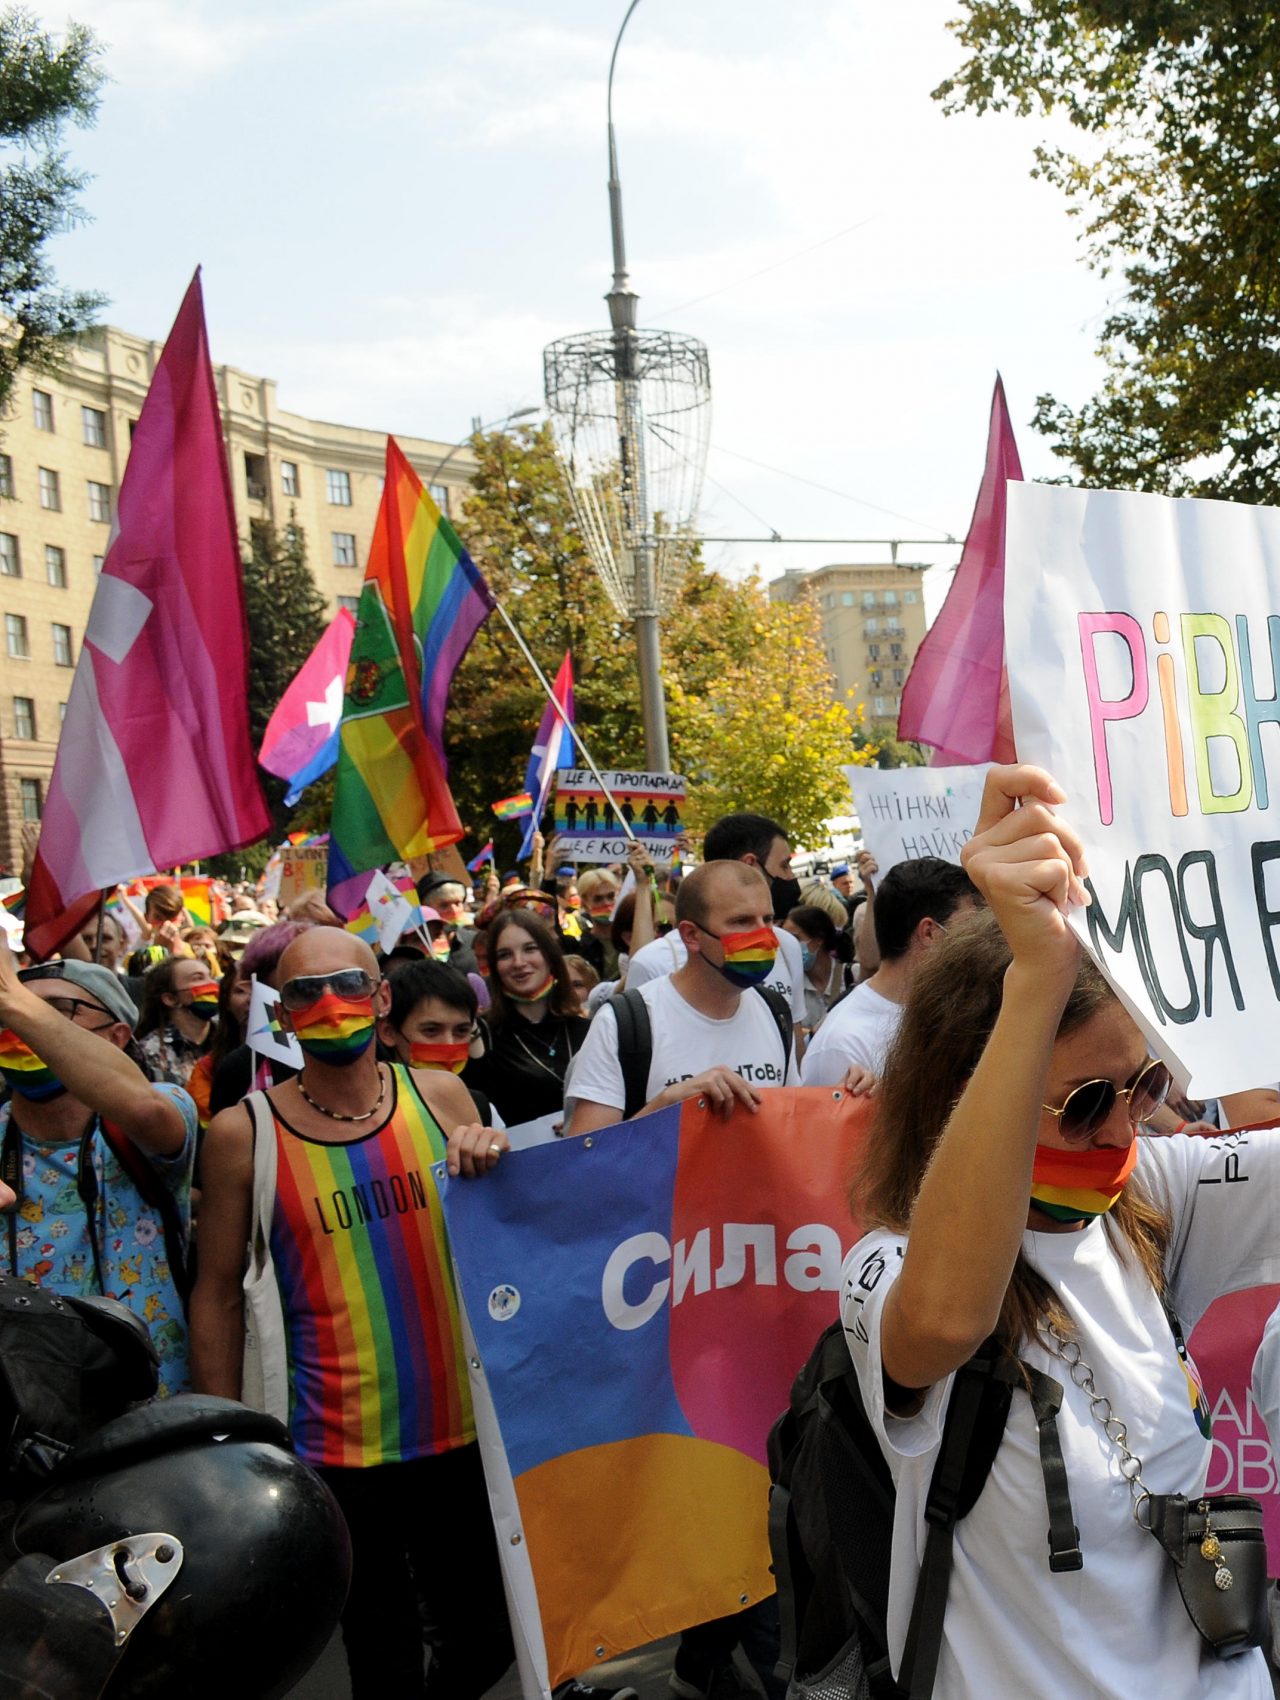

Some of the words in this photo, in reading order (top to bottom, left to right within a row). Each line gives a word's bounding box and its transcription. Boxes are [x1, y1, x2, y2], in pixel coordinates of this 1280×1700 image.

[565, 772, 585, 786] ЦЕ
[1084, 850, 1246, 1027] МОЯ
[314, 1170, 428, 1235] LONDON
[602, 1222, 843, 1332] Сила
